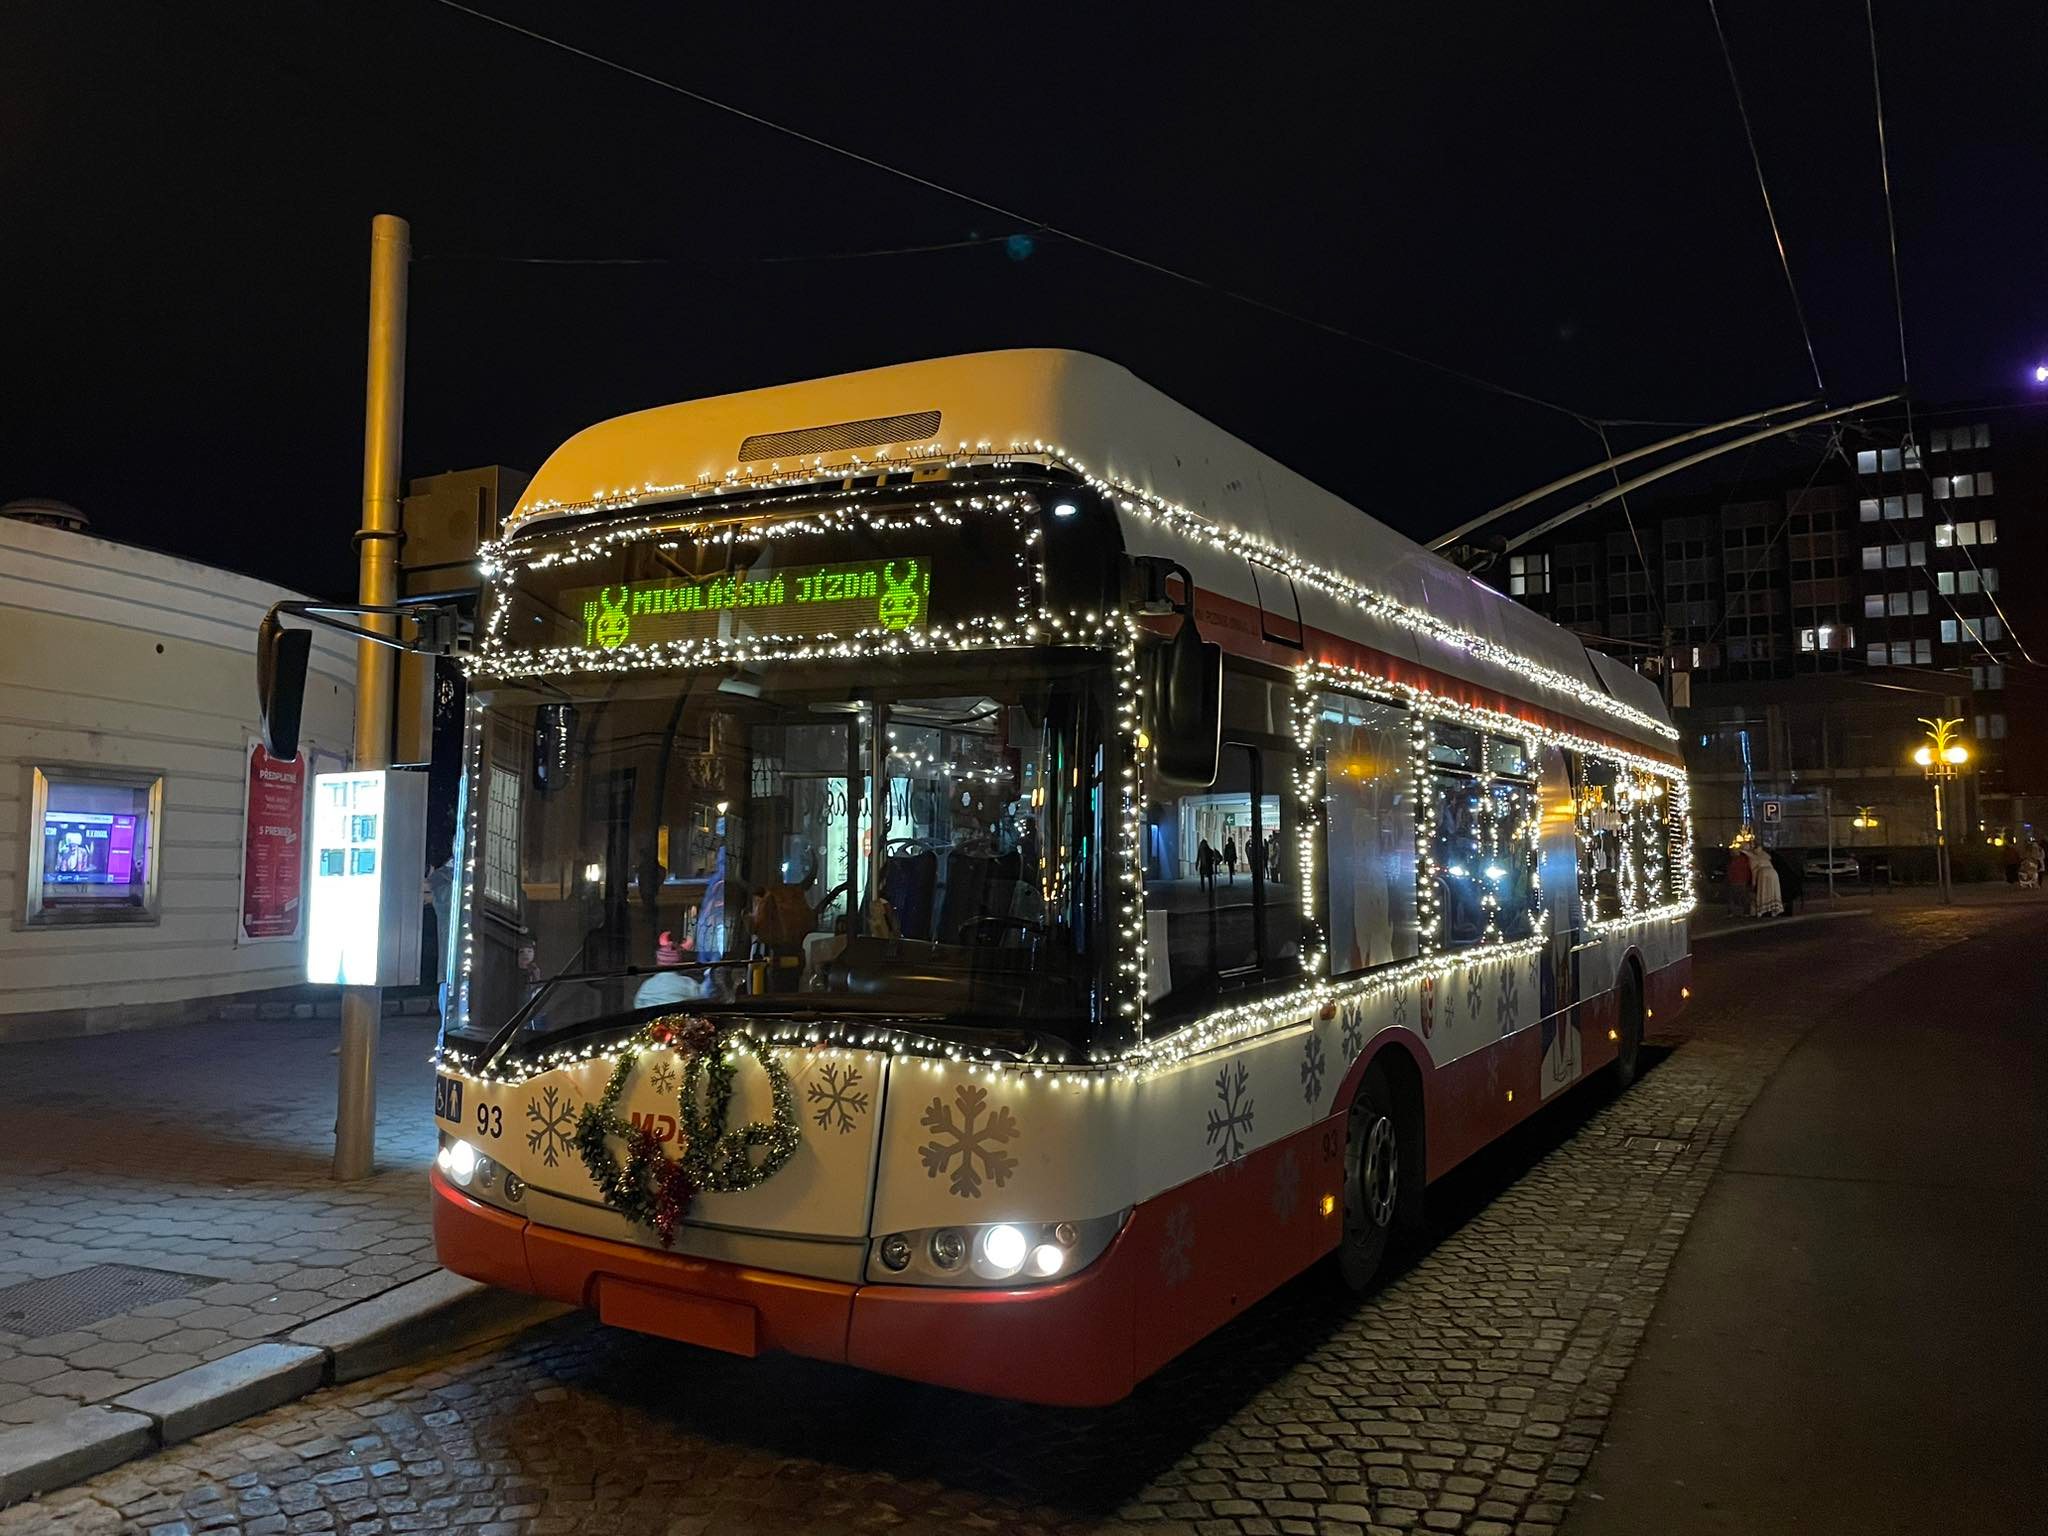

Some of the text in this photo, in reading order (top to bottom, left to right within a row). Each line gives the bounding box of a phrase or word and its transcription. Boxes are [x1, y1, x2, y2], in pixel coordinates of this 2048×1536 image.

[631, 568, 878, 616] MIKULÁŠSKÁ JÍZDA
[1766, 804, 1777, 817] P
[477, 1102, 503, 1139] 93
